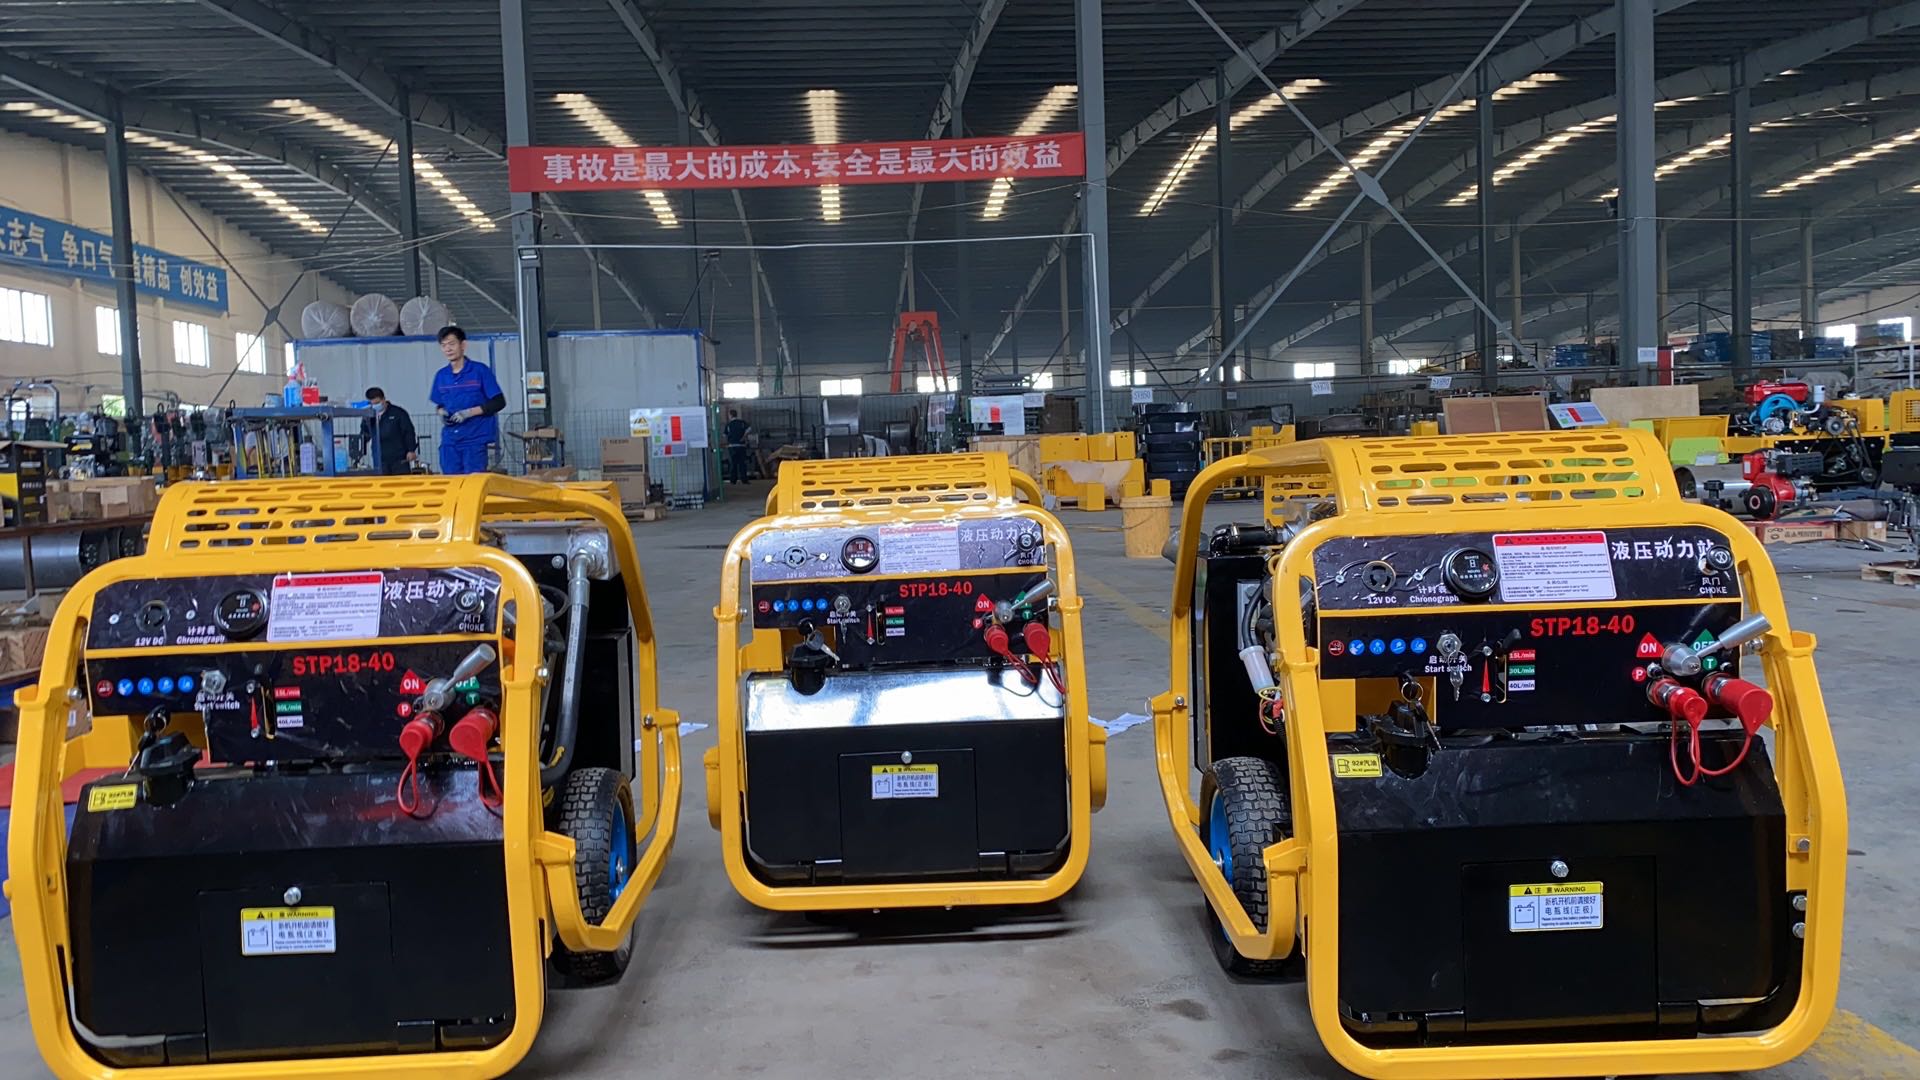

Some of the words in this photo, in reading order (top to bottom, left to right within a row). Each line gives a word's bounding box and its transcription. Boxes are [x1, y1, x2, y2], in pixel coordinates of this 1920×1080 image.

[542, 140, 1062, 184] 事故是最大的成本,安全是最大的效益
[0, 216, 49, 263] 志气
[899, 580, 974, 599] STP18-40
[1699, 586, 1728, 594] CHOKE
[977, 600, 990, 609] ON
[1367, 595, 1383, 605] 12V
[1384, 594, 1397, 604] DC
[1409, 594, 1460, 604] Chronograph
[1024, 611, 1031, 620] T
[975, 618, 982, 628] P
[1530, 613, 1636, 637] STP18-40
[135, 638, 152, 647] 12V
[152, 636, 164, 646] DC
[1640, 642, 1658, 654] ON
[292, 651, 396, 676] STP18-40
[1424, 664, 1446, 673] Start
[1706, 658, 1715, 669] T
[1635, 669, 1644, 679] P
[402, 679, 420, 690] ON
[469, 693, 477, 704] T
[401, 705, 409, 715] P
